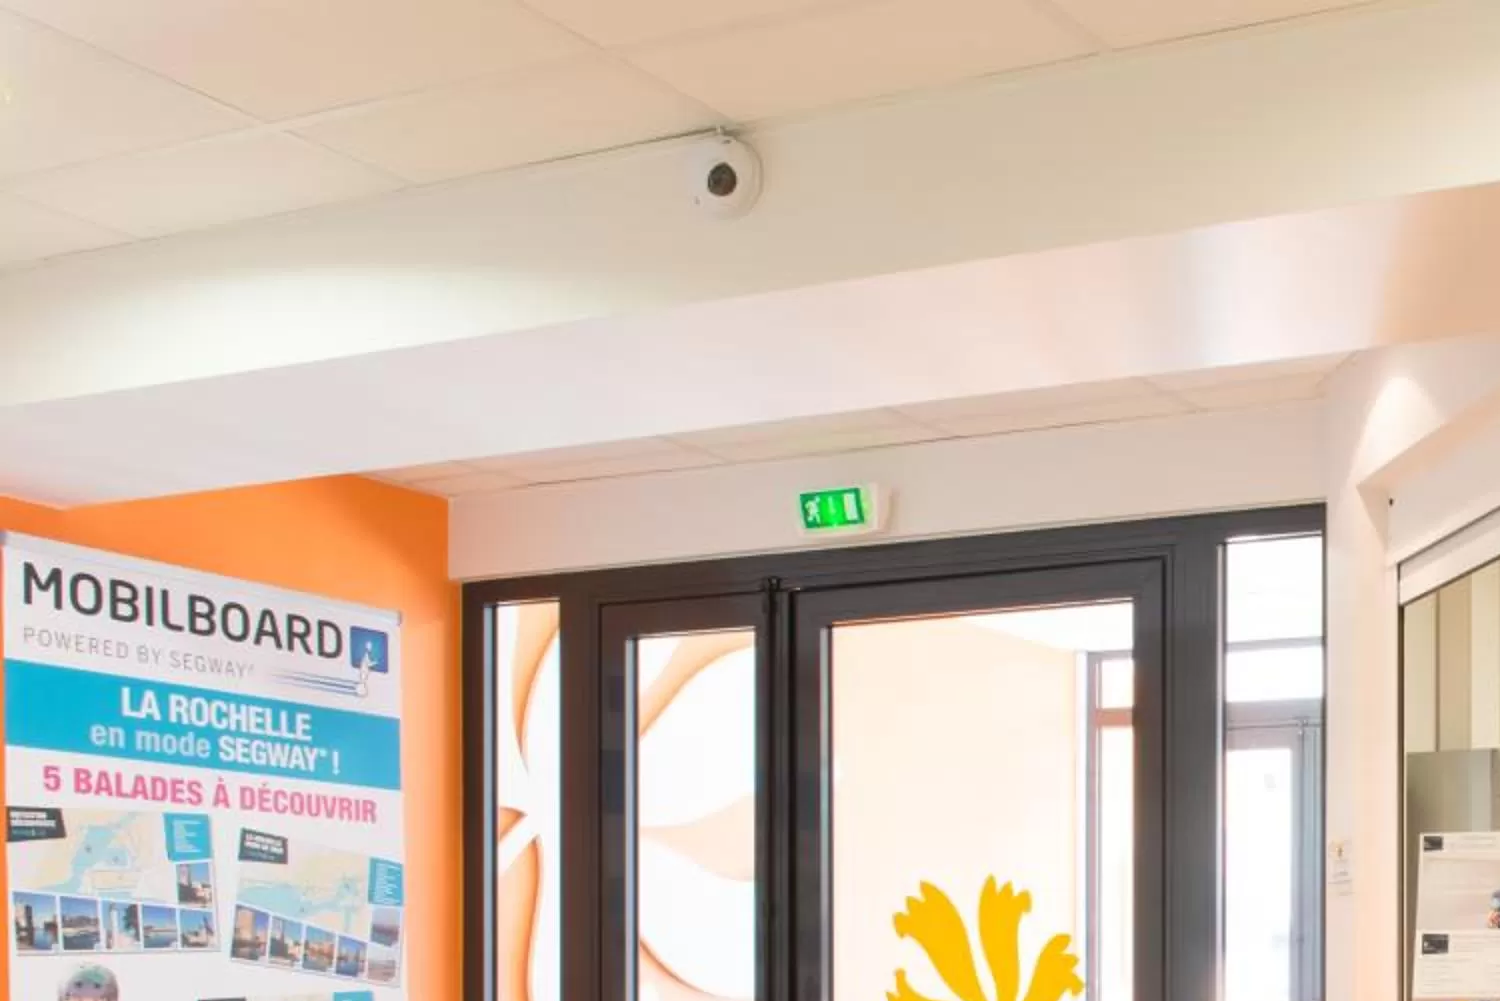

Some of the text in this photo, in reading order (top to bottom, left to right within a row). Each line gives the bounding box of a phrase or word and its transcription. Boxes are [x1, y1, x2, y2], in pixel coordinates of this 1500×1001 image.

[22, 560, 344, 660] MOBILBOARD
[23, 626, 129, 660] POWERED
[138, 644, 162, 664] BY
[90, 723, 125, 748] en
[135, 728, 211, 760] mode
[120, 686, 313, 742] LA ROCHELLE
[43, 764, 378, 825] 5 BALADES À DÉCOUVRIR
